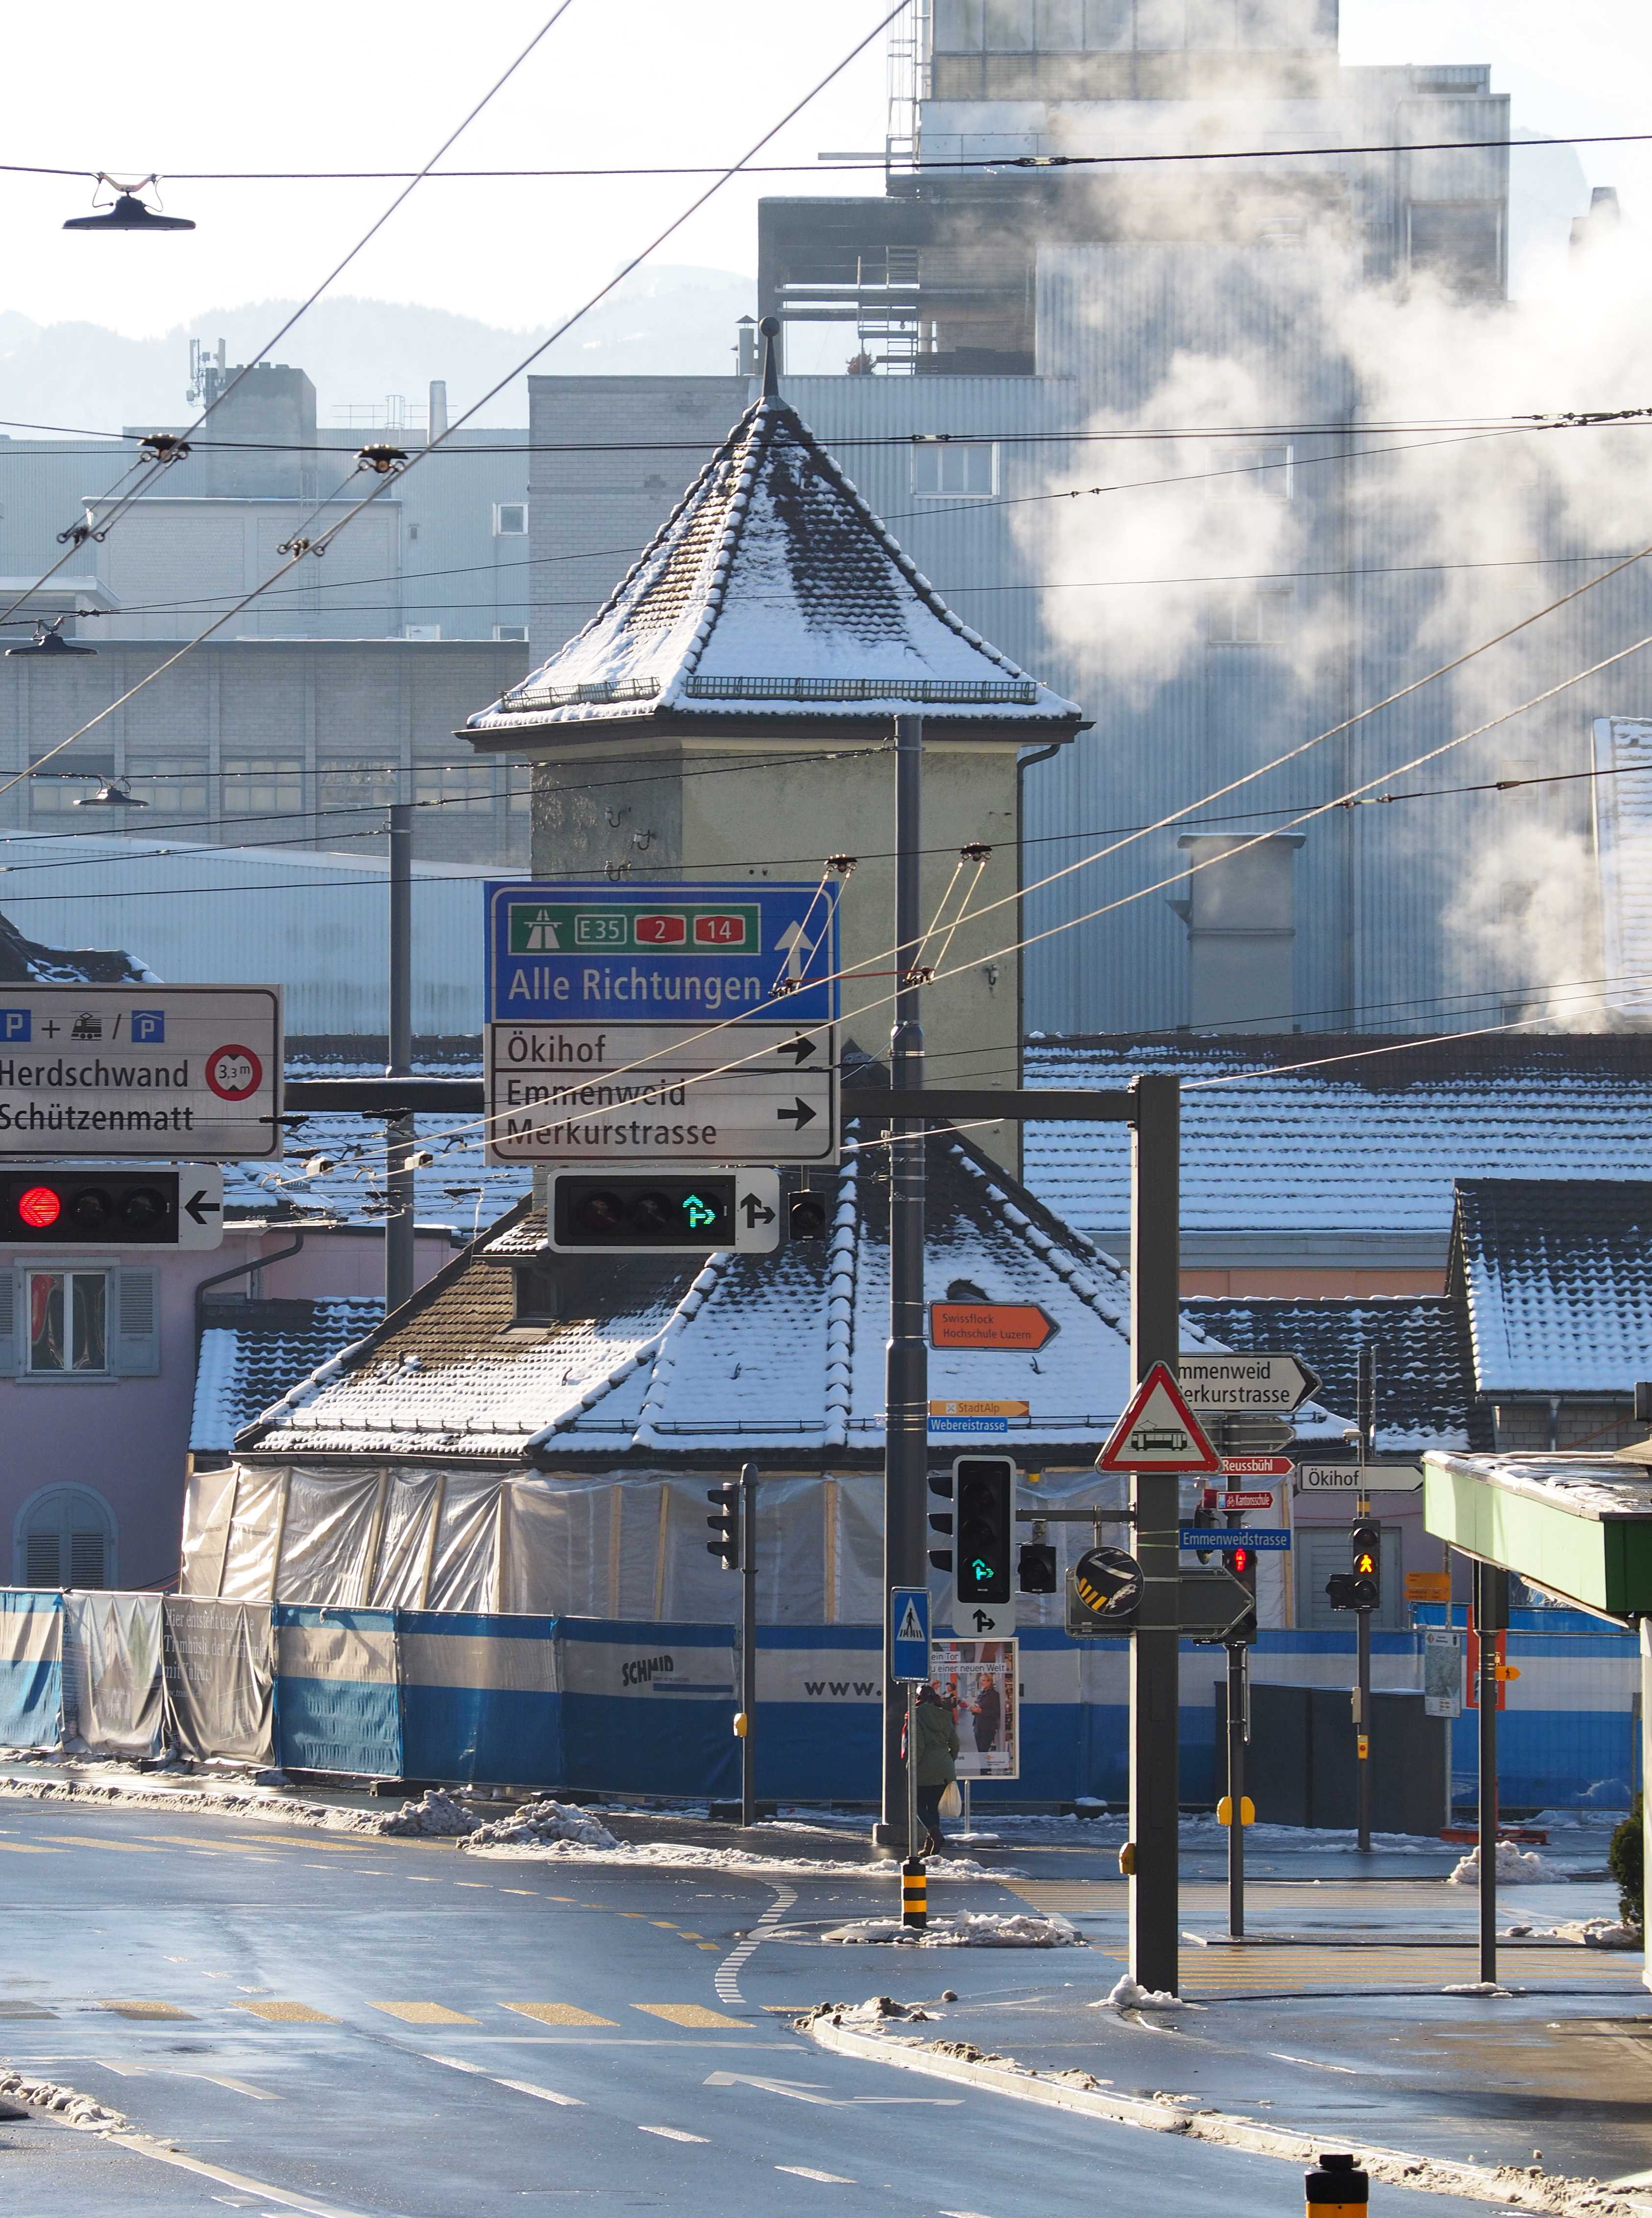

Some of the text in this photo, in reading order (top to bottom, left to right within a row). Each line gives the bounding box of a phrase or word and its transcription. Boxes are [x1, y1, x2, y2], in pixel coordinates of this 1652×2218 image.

[654, 920, 666, 939] 2
[707, 921, 731, 939] 14
[508, 967, 761, 1009] Alle Richtungen
[508, 1032, 605, 1062] Ökihof
[0, 1058, 188, 1087] Herdschwand
[508, 1078, 685, 1105] Emmenweid
[0, 1102, 193, 1130] Schützenmatt
[508, 1118, 716, 1145] Merkurstrasse
[943, 1314, 994, 1324] Swissflock
[944, 1329, 1031, 1339] Hochschule Luzern
[1178, 1361, 1270, 1380] mmenweid
[1180, 1384, 1290, 1403] erkurstrasse
[958, 1403, 1000, 1415] StadtAlp
[931, 1420, 1005, 1431] Webereistrasse
[1222, 1459, 1273, 1471] Reussbühl
[1309, 1468, 1360, 1486] Ökihof
[1235, 1494, 1270, 1506] Kantonsschule
[1183, 1532, 1287, 1546] Emmenweidstrasse
[220, 1611, 233, 1630] das
[622, 1655, 673, 1686] SCHMID
[937, 1664, 957, 1672] einer
[986, 1663, 1005, 1672] Welt
